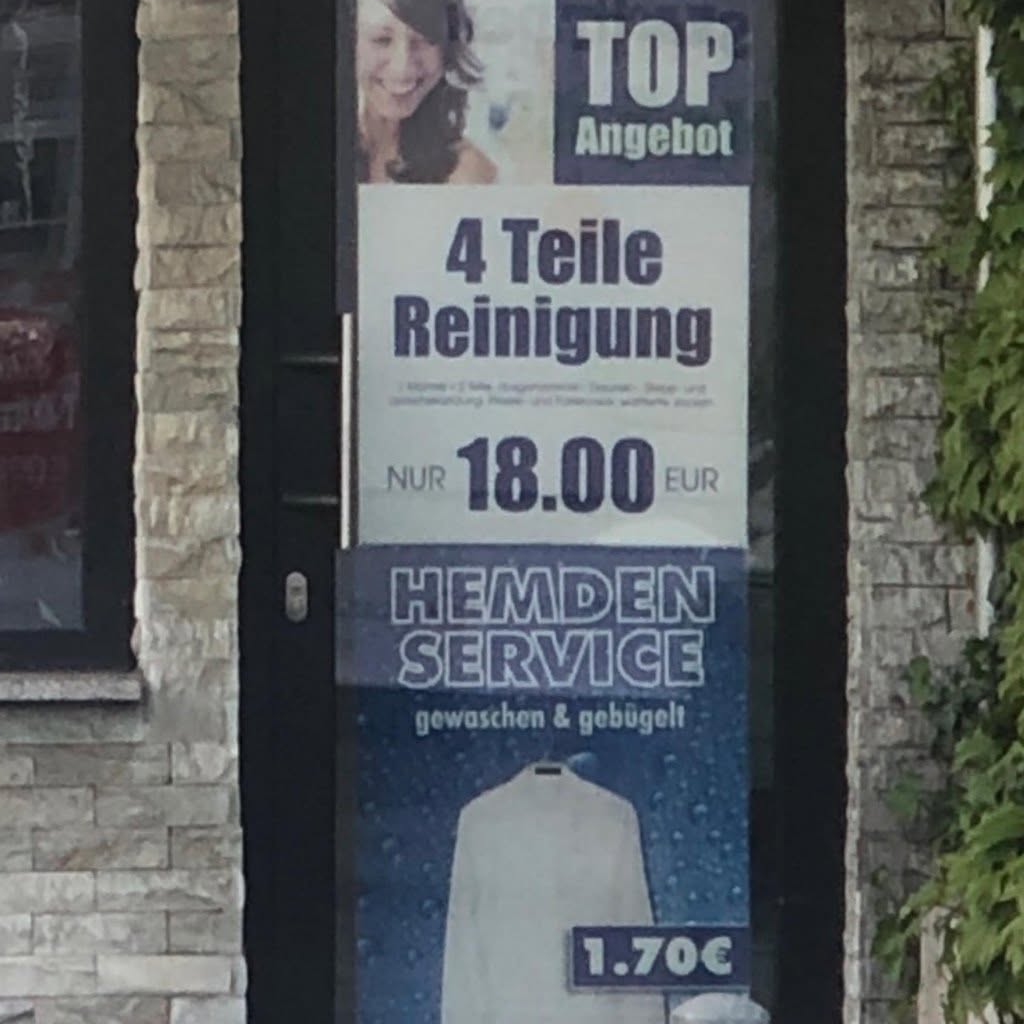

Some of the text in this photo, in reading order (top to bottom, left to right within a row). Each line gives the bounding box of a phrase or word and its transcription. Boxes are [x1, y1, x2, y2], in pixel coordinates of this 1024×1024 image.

[576, 19, 736, 108] TOP
[575, 116, 734, 160] Angebot
[446, 218, 664, 286] 4 Teile
[393, 295, 713, 368] Reinigung
[386, 435, 720, 515] NUR 18.00 EUR
[390, 565, 717, 626] HEMDEN
[397, 630, 706, 690] SERVICE
[414, 701, 686, 736] gewaschen & gebügelt
[583, 936, 734, 976] 1.70€
